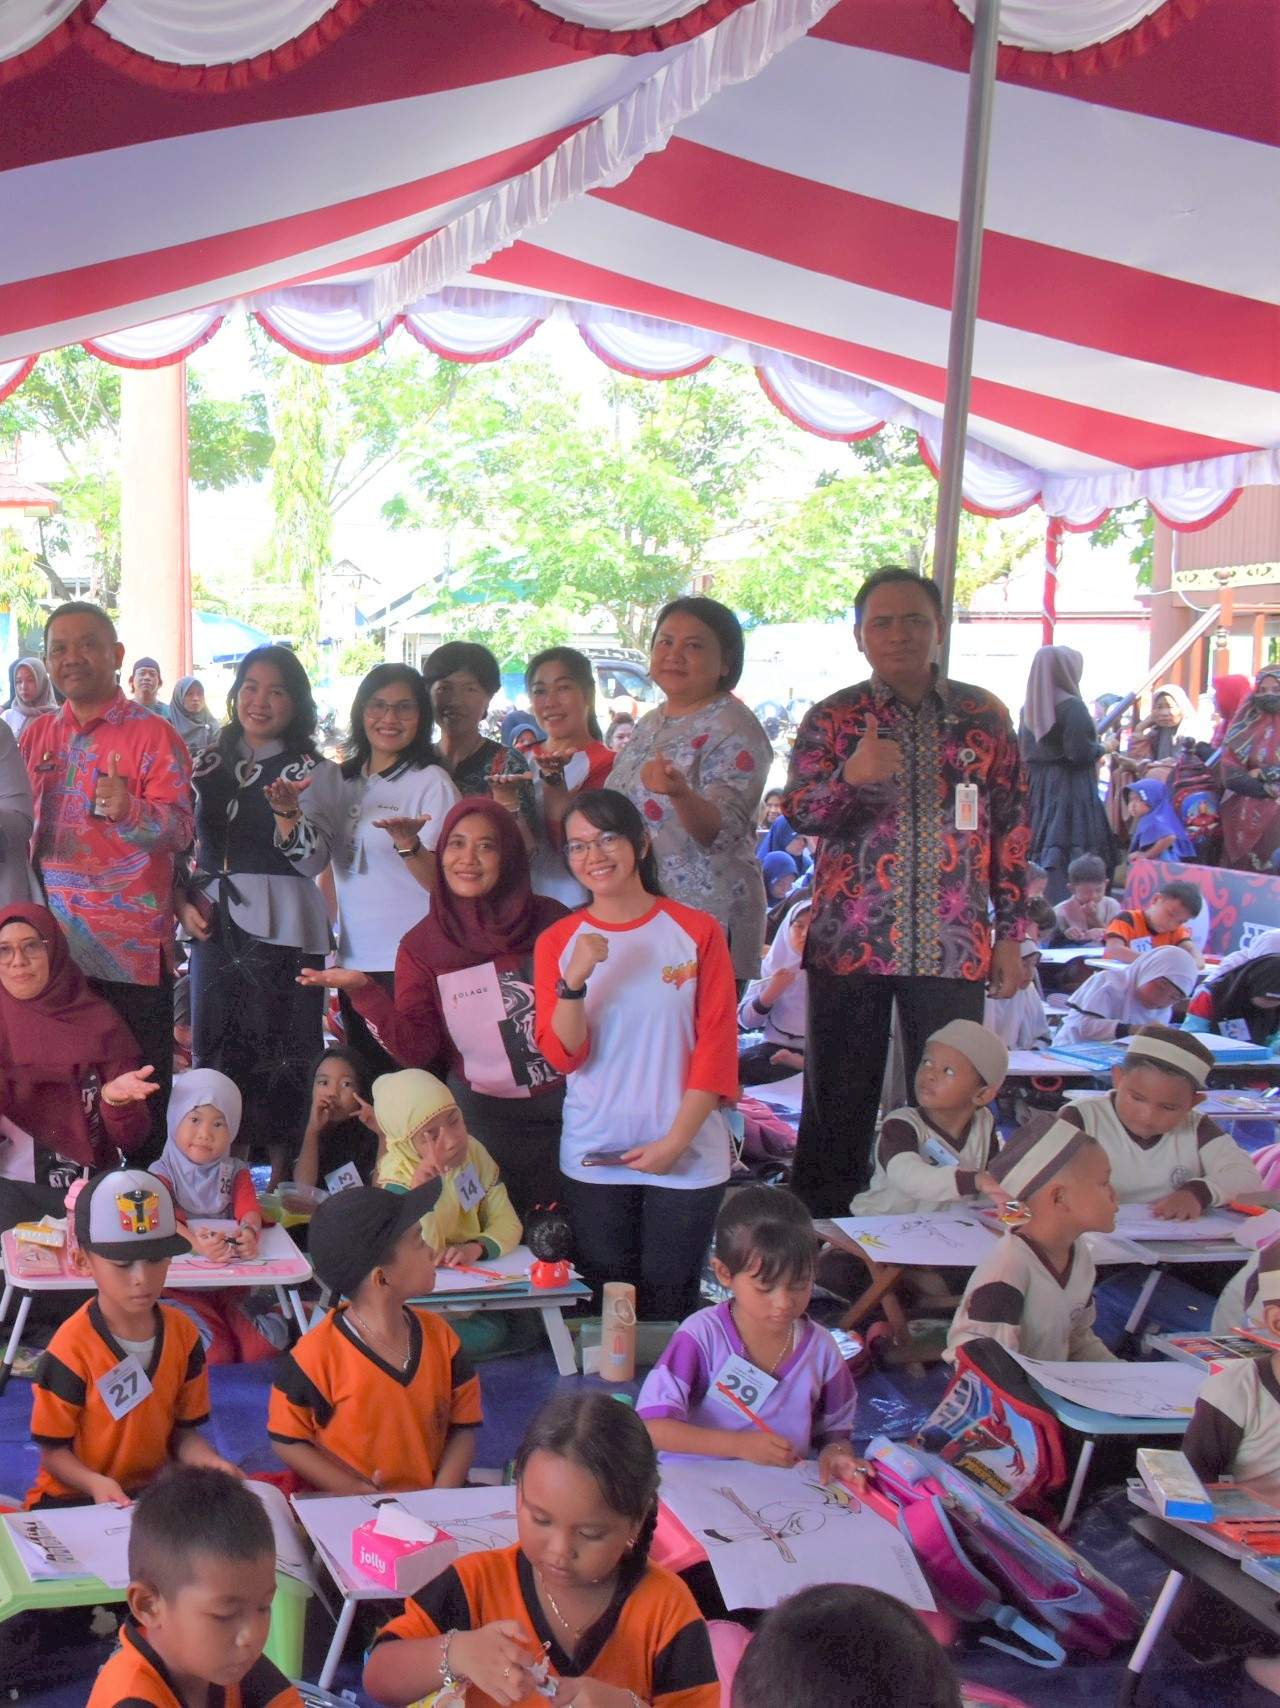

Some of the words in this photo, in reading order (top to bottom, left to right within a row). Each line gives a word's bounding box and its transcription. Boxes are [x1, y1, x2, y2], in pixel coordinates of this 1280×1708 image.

[460, 1178, 478, 1201] 14
[109, 1371, 138, 1408] 27
[721, 1374, 759, 1406] 29
[359, 1545, 387, 1574] jolly
